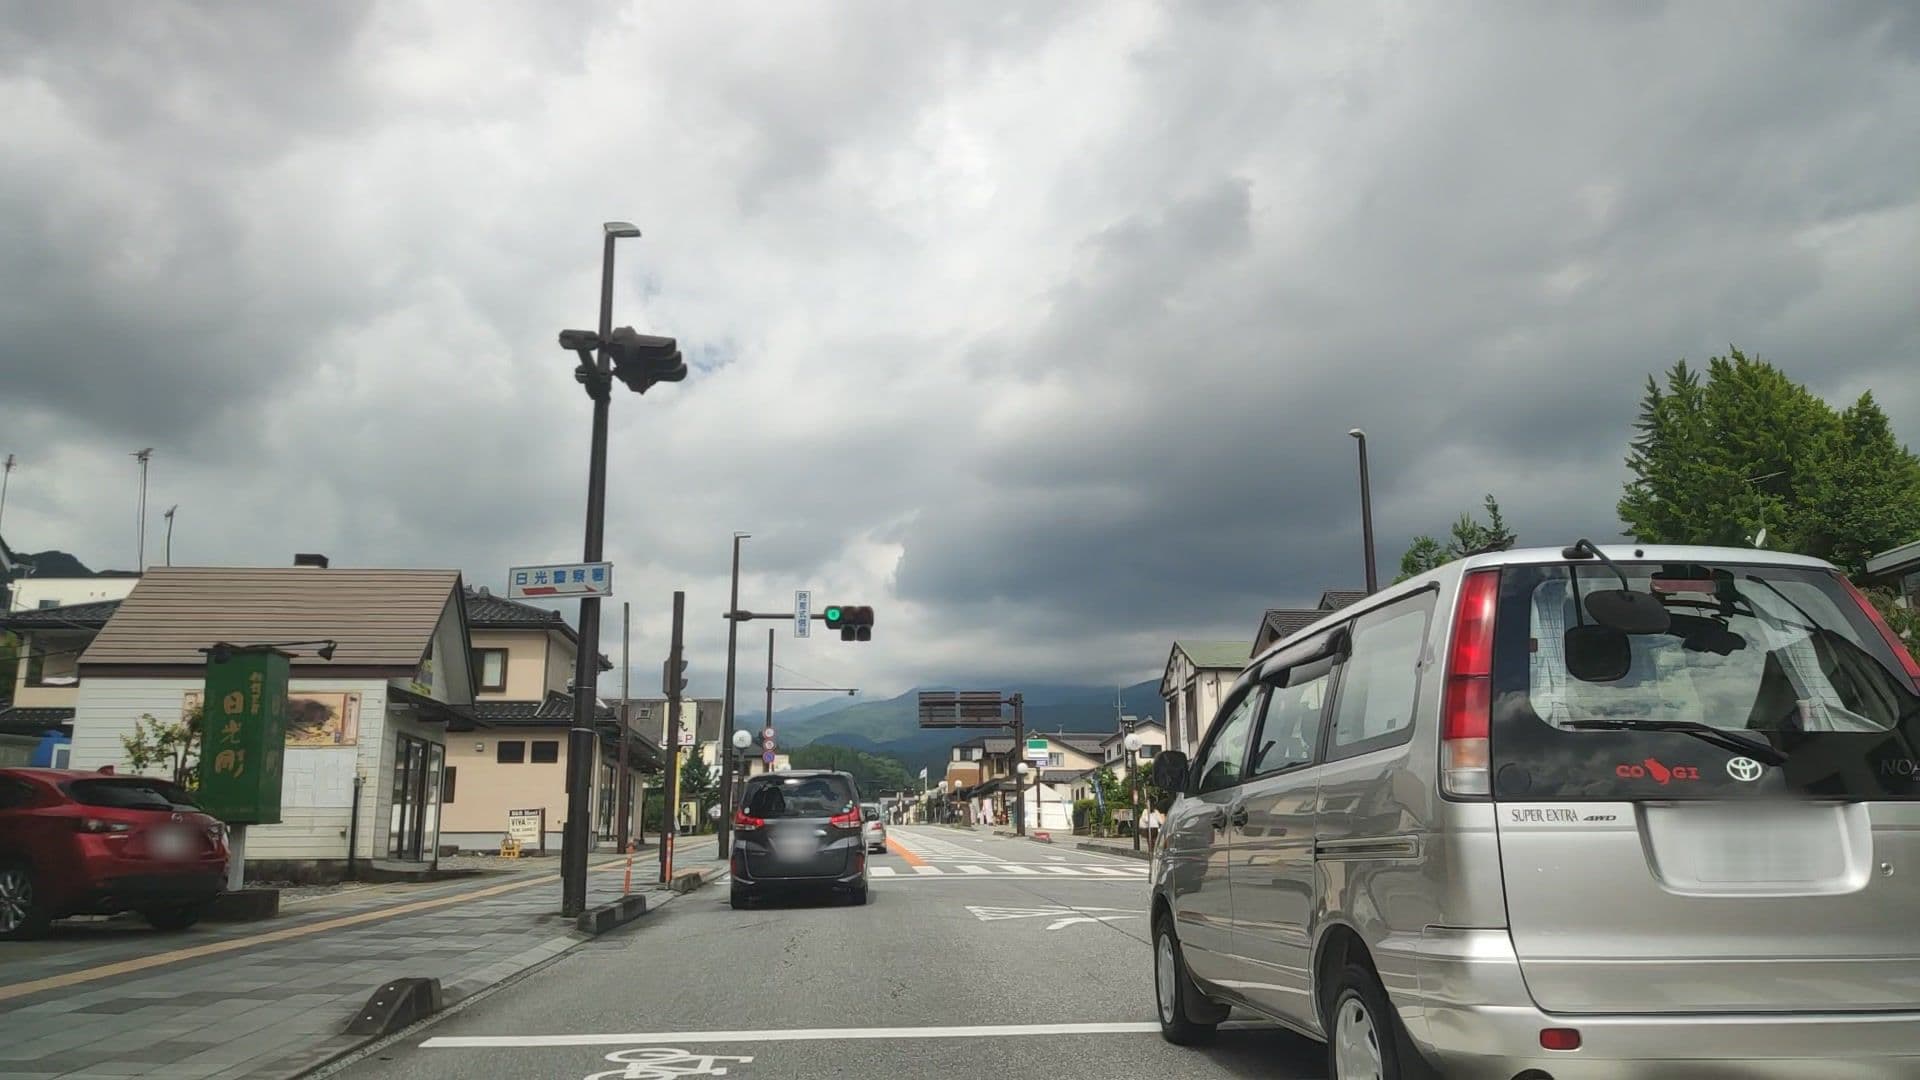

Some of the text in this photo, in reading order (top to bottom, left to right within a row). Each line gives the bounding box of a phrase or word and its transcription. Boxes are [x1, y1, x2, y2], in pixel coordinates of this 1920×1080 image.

[516, 567, 605, 585] 日光警察署
[1512, 808, 1617, 822] SUPER EXTRA 4WD
